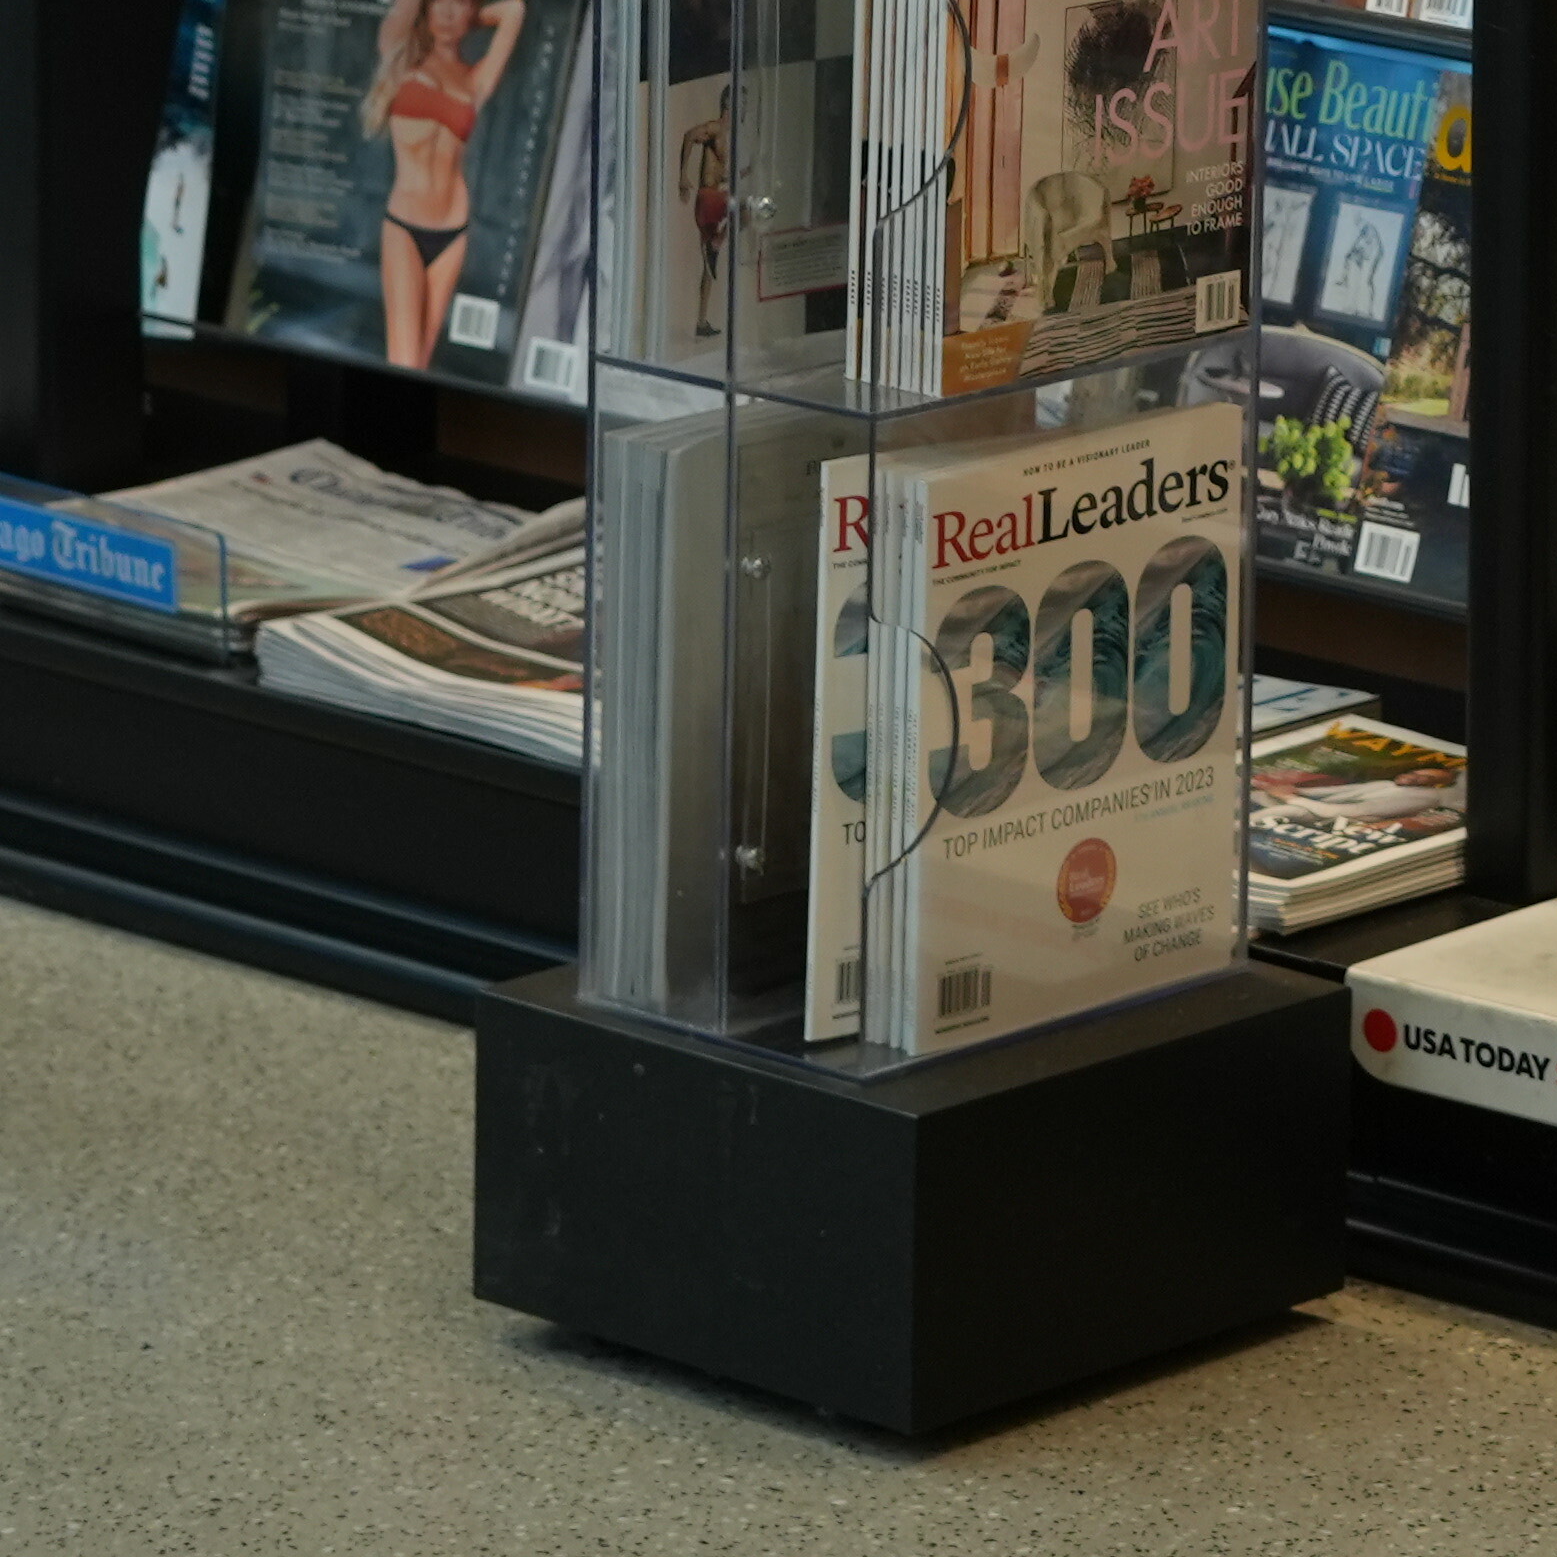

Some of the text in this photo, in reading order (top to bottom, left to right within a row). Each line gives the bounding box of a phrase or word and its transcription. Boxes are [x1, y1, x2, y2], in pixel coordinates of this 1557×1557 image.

[52, 521, 166, 591] Tribune
[941, 767, 1214, 861] TOP IMPACT COMPANIES IN 2023
[1403, 1026, 1455, 1060] USA
[1461, 1038, 1551, 1080] TODAY
